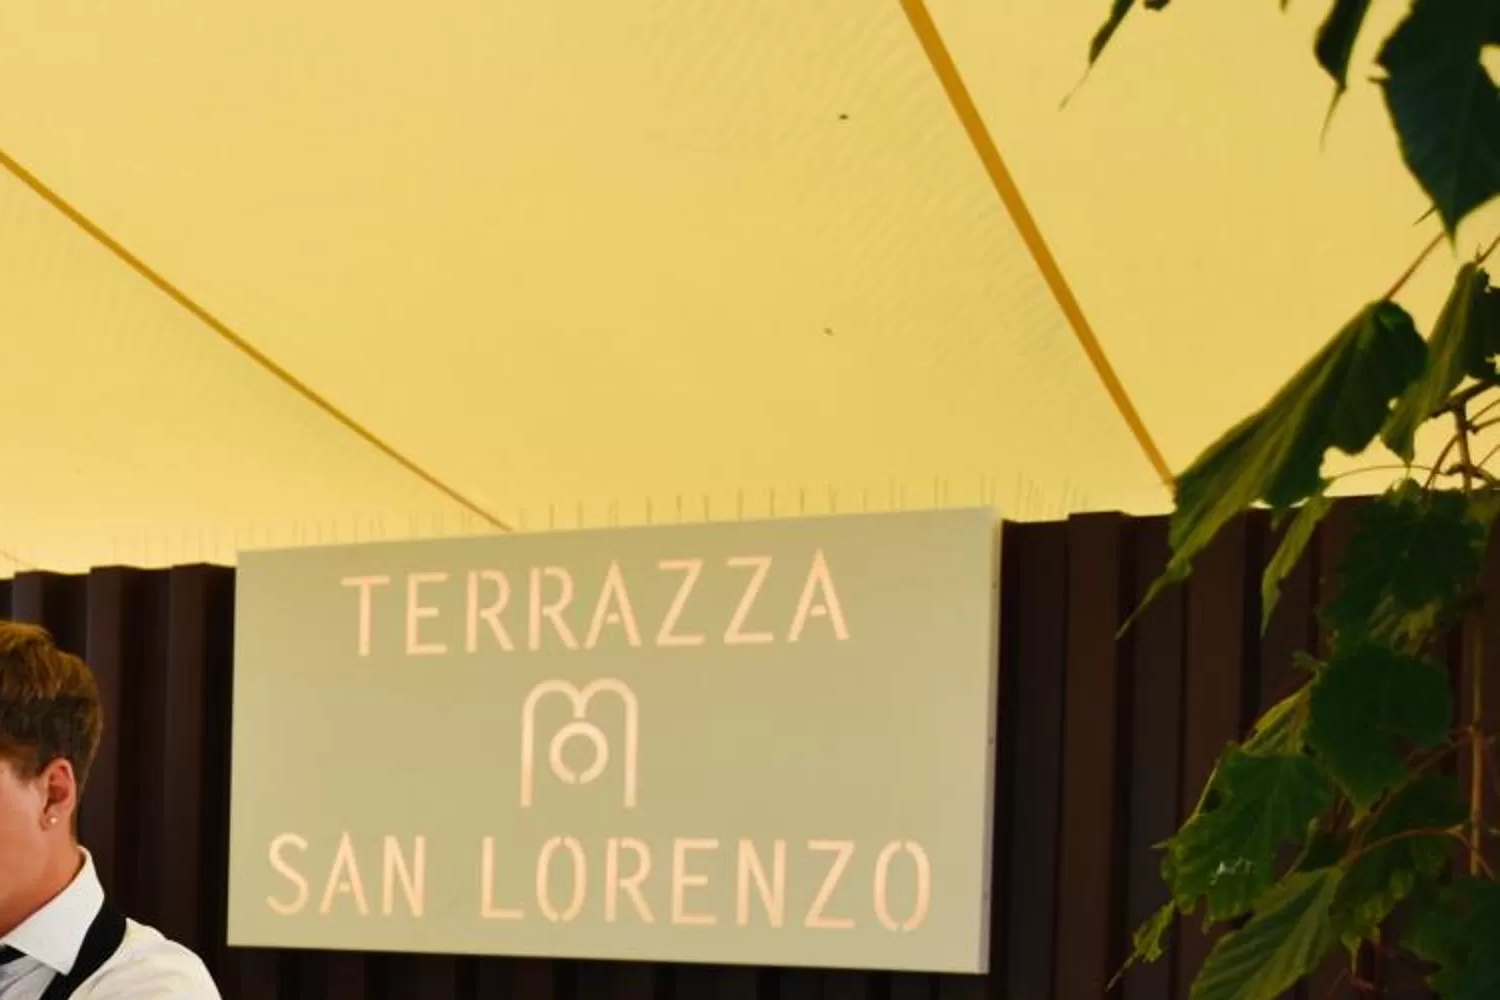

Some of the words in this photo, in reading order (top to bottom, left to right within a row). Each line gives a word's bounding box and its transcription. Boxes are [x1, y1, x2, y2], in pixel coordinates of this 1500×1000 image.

[341, 548, 851, 657] TERRAZZA
[266, 832, 426, 918] SAN
[479, 835, 932, 931] LORENZO
